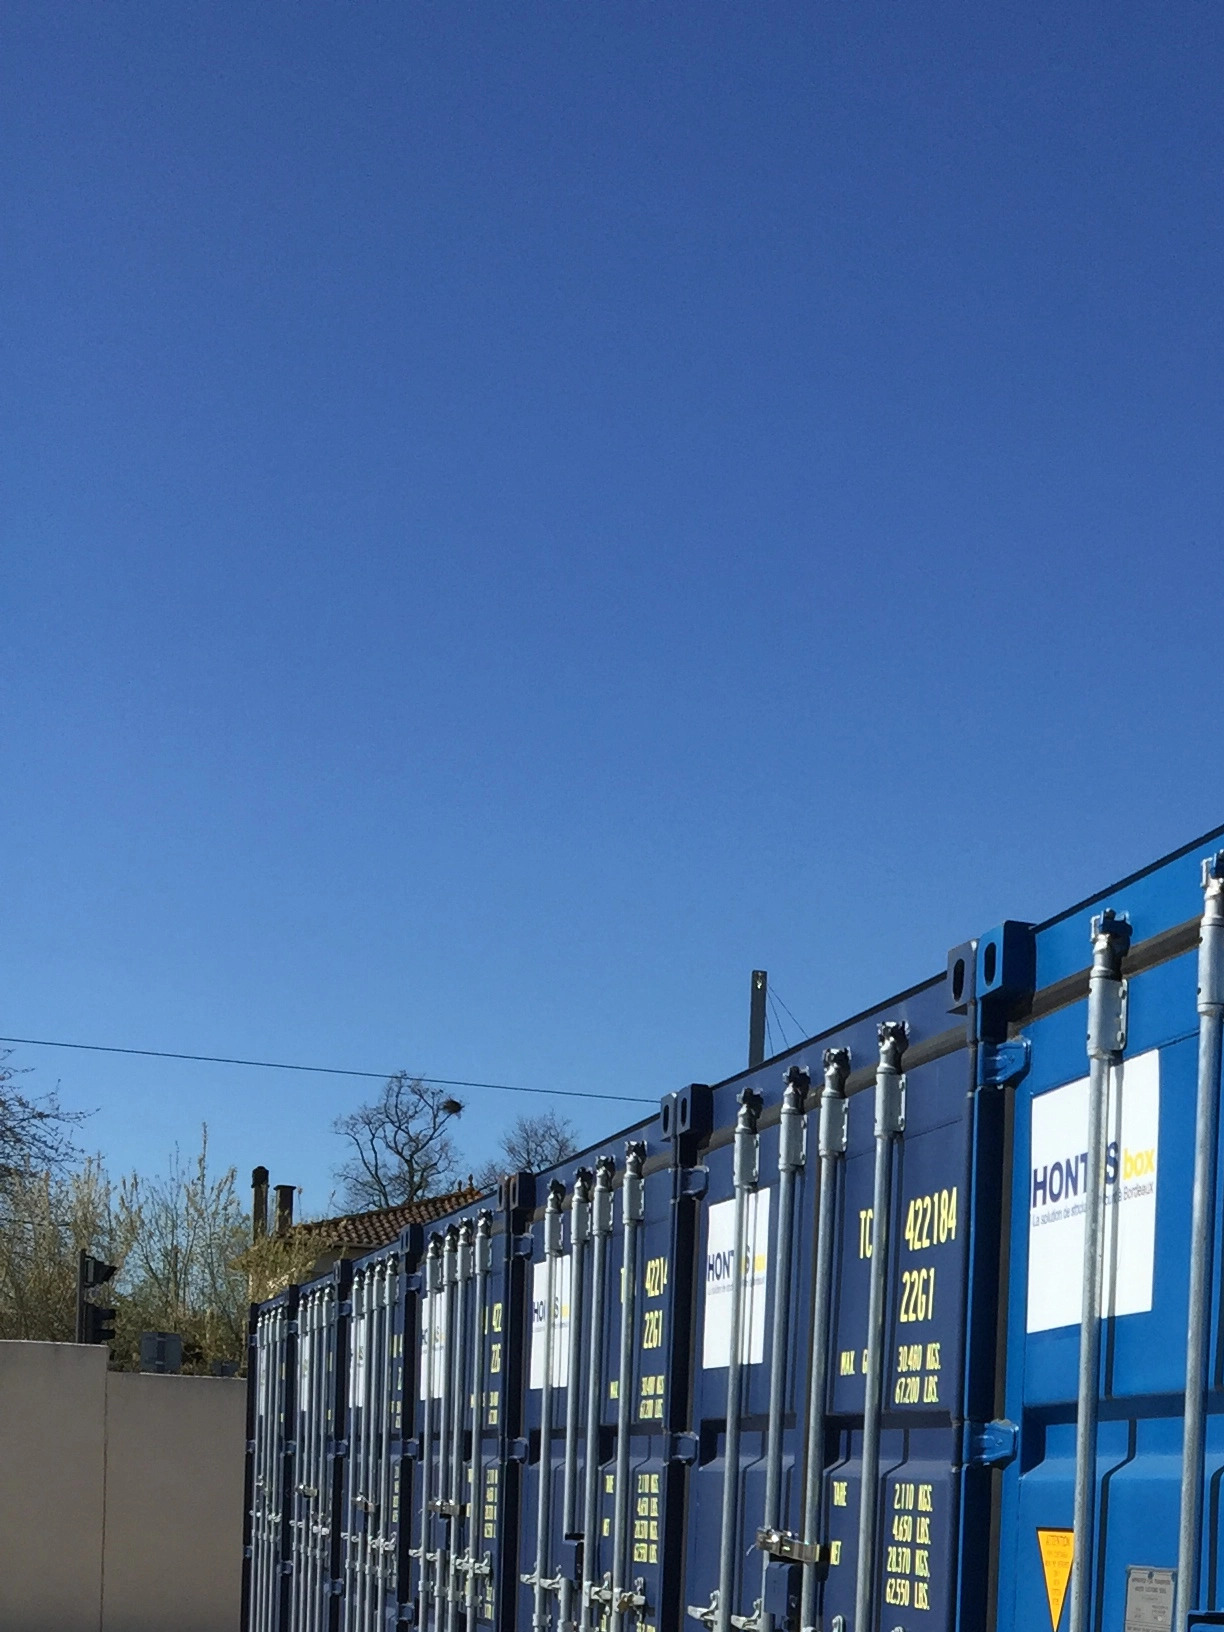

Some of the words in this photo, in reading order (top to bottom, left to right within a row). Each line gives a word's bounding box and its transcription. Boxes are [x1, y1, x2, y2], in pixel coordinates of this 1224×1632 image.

[1033, 1141, 1119, 1208] HONTS
[1122, 1147, 1155, 1181] box
[904, 1186, 957, 1251] 422184
[900, 1267, 935, 1322] 22G1
